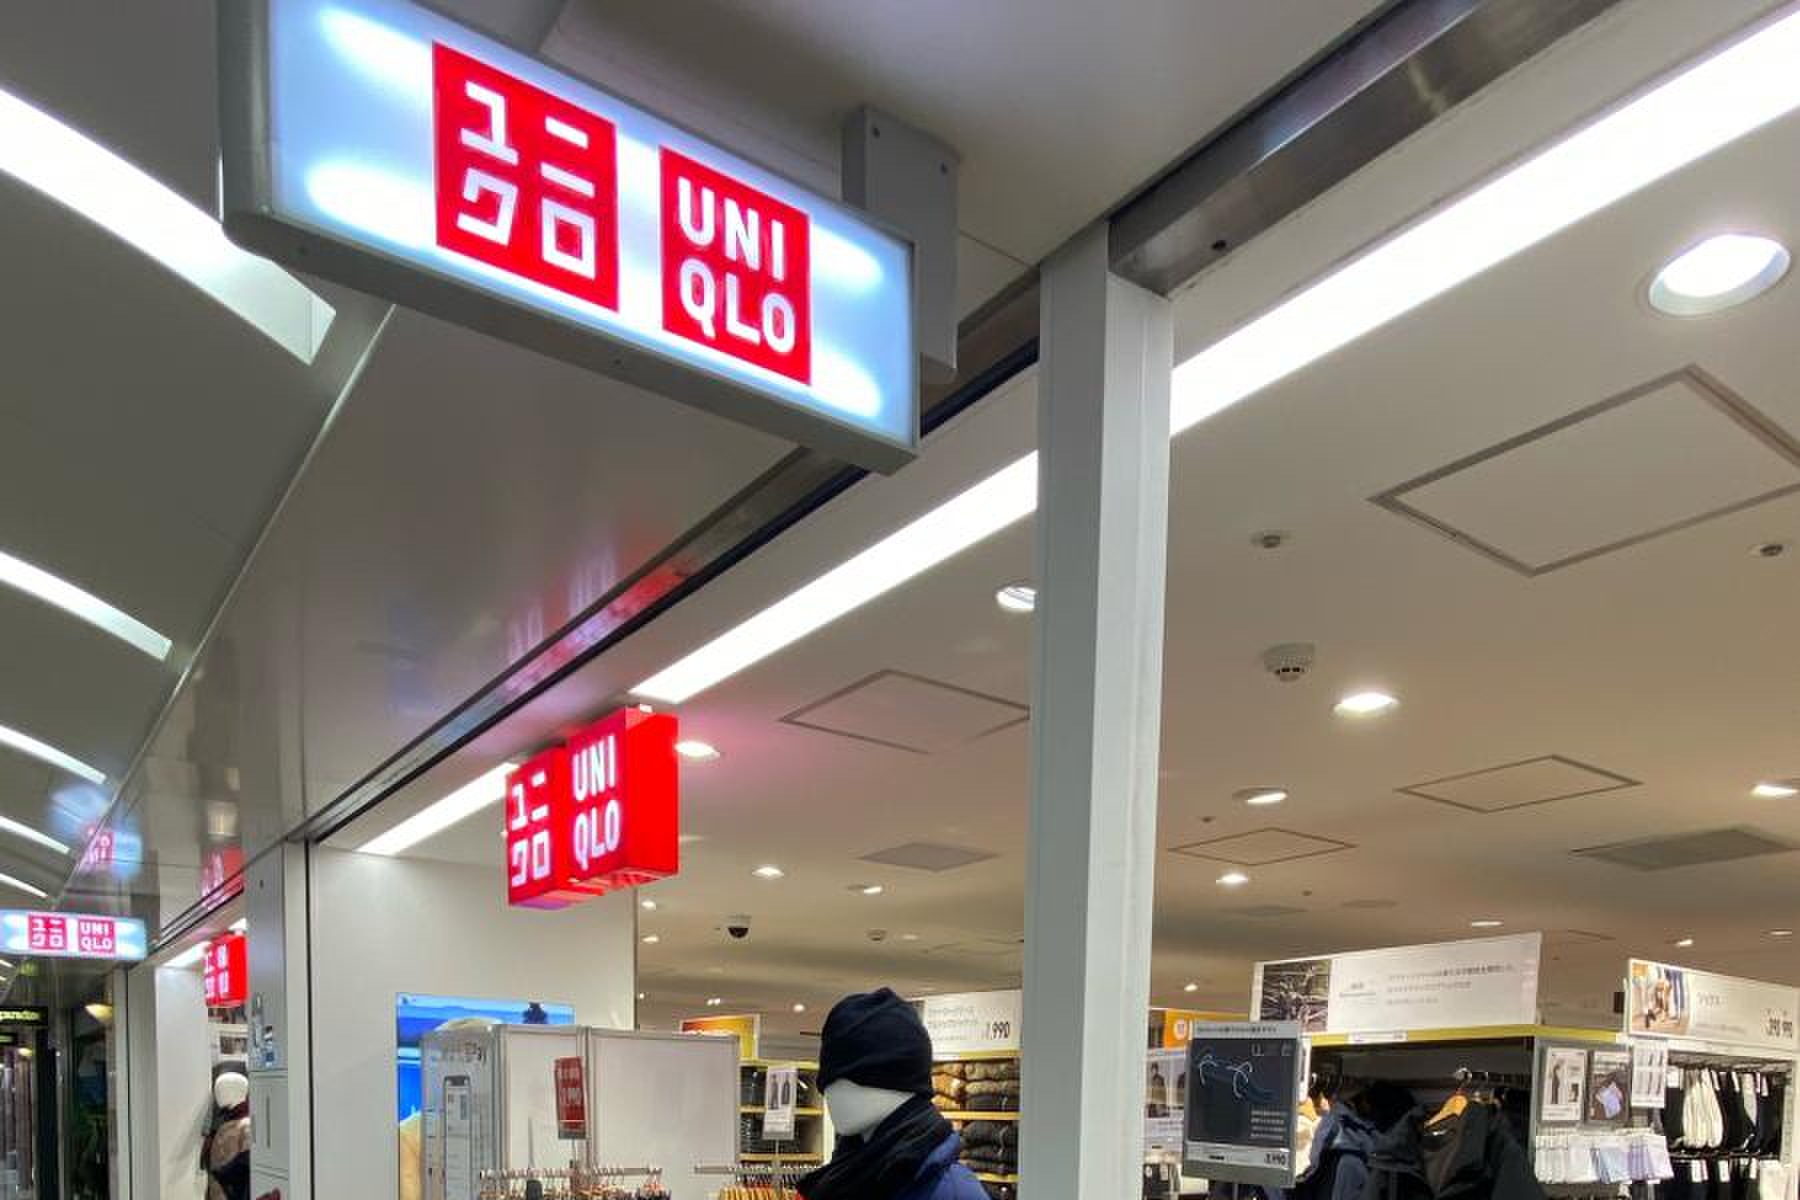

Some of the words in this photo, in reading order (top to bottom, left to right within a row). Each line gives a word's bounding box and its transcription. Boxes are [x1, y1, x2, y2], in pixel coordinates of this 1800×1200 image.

[459, 80, 596, 197] ユニ
[457, 168, 596, 280] クロ
[677, 176, 785, 281] UNI
[679, 261, 796, 355] QLO
[572, 733, 616, 801] UNI
[573, 799, 620, 871] QLO
[80, 920, 109, 934] UNI
[81, 936, 113, 950] QLO
